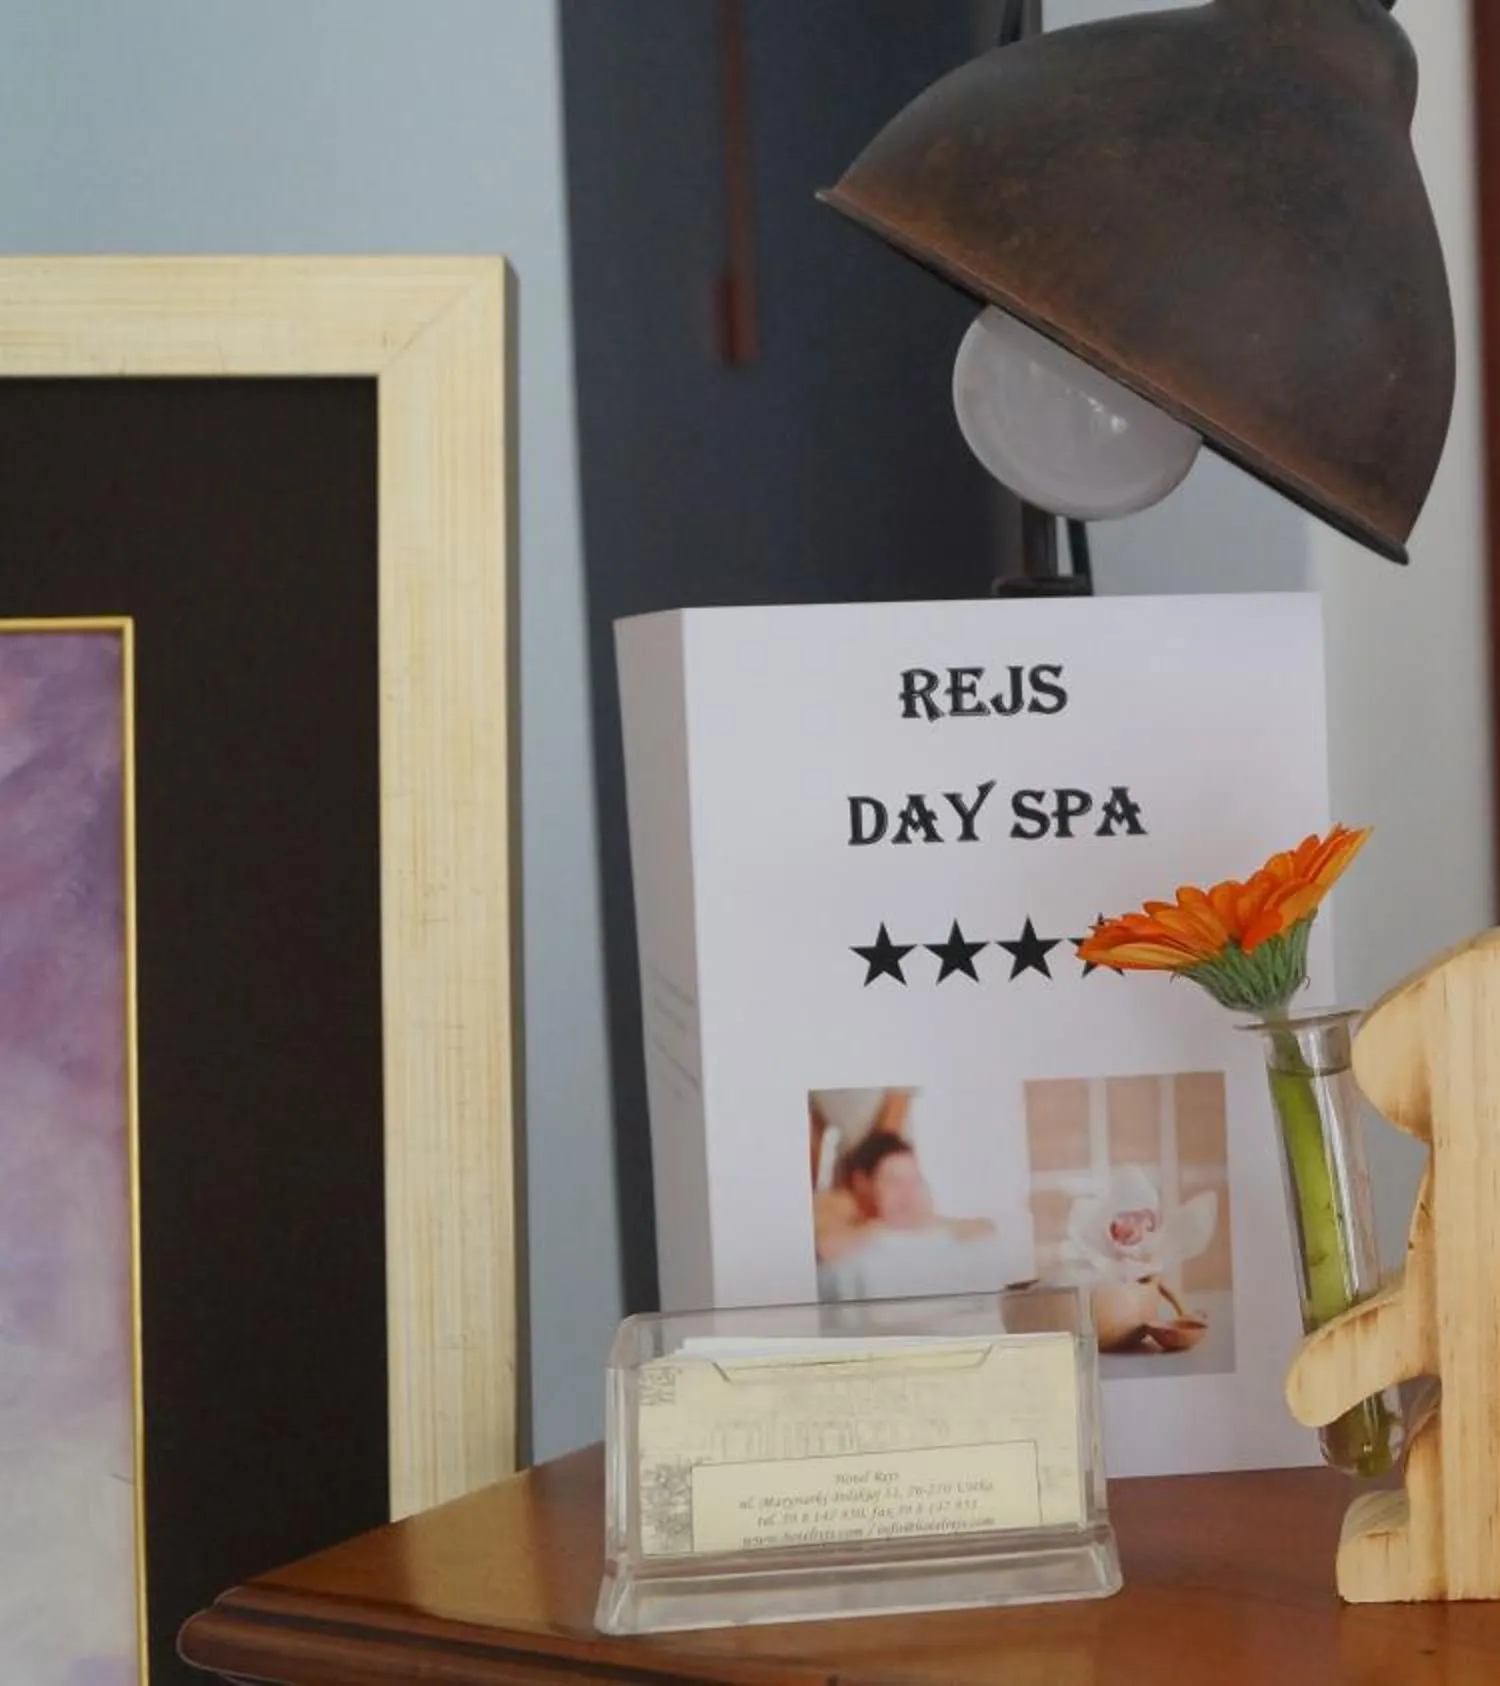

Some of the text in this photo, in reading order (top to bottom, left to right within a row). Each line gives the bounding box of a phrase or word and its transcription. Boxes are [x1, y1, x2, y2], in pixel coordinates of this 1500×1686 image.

[899, 664, 1068, 722] REJS
[847, 780, 1148, 846] DAY SPA
